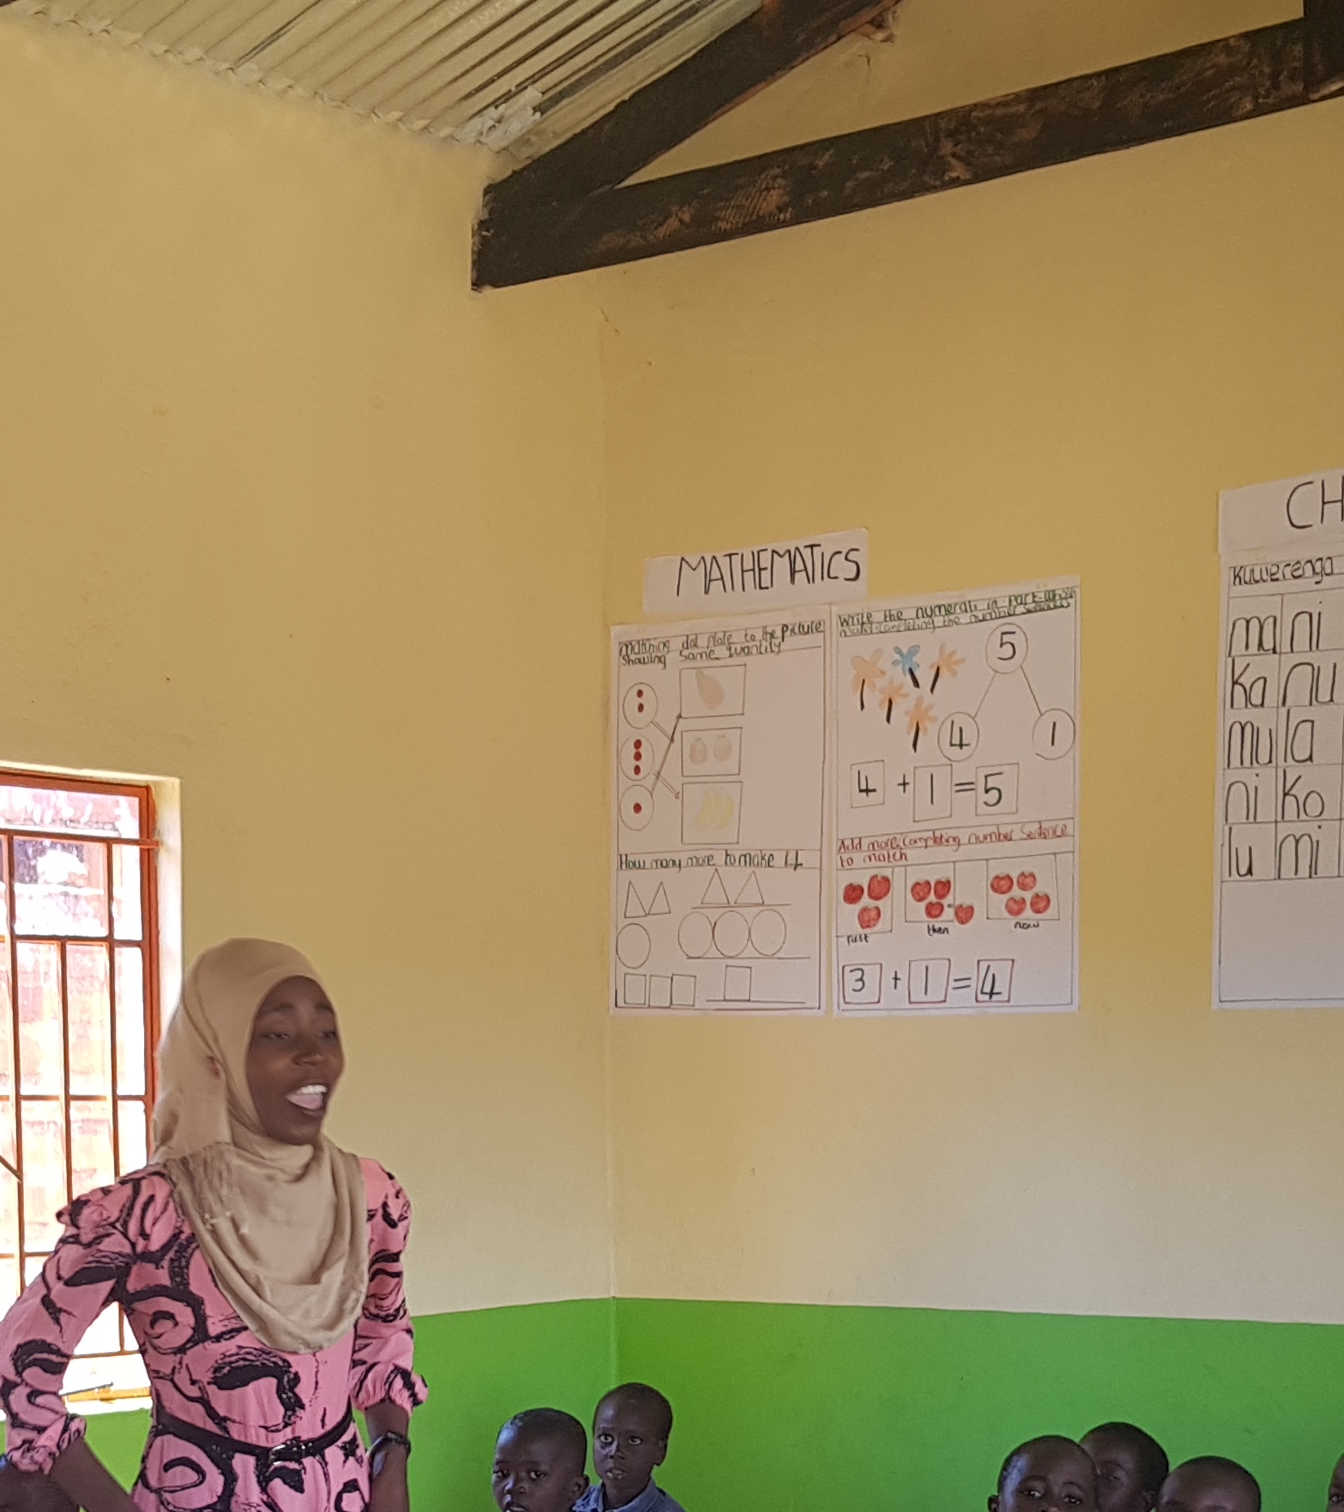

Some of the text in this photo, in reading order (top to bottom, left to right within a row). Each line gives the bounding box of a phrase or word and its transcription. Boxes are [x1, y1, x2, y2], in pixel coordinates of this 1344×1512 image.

[676, 543, 861, 597] MATHEMATICS
[997, 631, 1017, 661] 5
[1228, 615, 1277, 657] ma
[1290, 601, 1323, 653] ni
[1282, 662, 1336, 707] nu
[949, 720, 1057, 750] 4 1
[1227, 720, 1273, 768] mu
[1284, 709, 1314, 763] la
[857, 769, 1004, 807] 4 + 1 = 5
[1225, 773, 1259, 822] ni
[619, 853, 646, 870] How
[738, 850, 775, 867] make
[839, 837, 862, 852] Add
[863, 850, 908, 863] match
[1229, 826, 1253, 877] lu
[1278, 825, 1322, 879] mi
[927, 924, 949, 936] then
[849, 968, 865, 992] 3
[892, 971, 901, 990] +
[952, 977, 971, 990] =
[980, 965, 1002, 1000] 4
